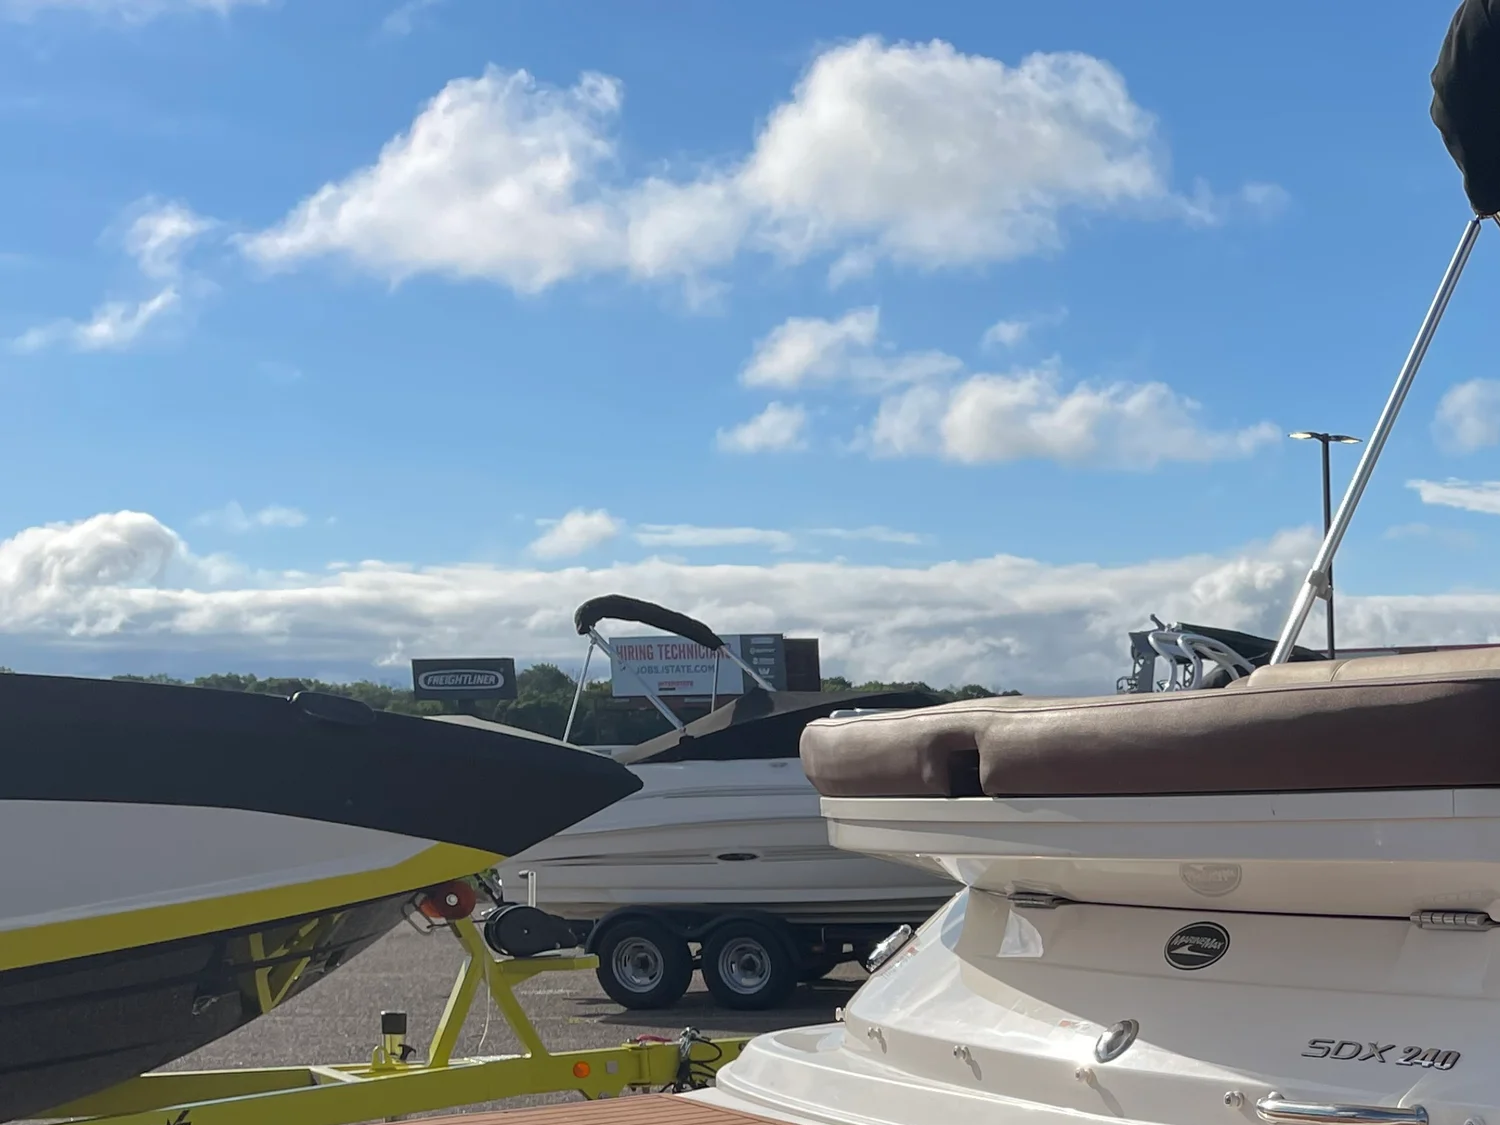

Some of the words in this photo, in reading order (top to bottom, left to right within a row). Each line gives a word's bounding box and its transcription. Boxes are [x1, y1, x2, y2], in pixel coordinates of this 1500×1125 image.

[616, 643, 654, 661] HIRING
[427, 674, 496, 685] FREIGHTLINER
[1301, 1038, 1396, 1063] SDX
[1395, 1045, 1461, 1071] 240
